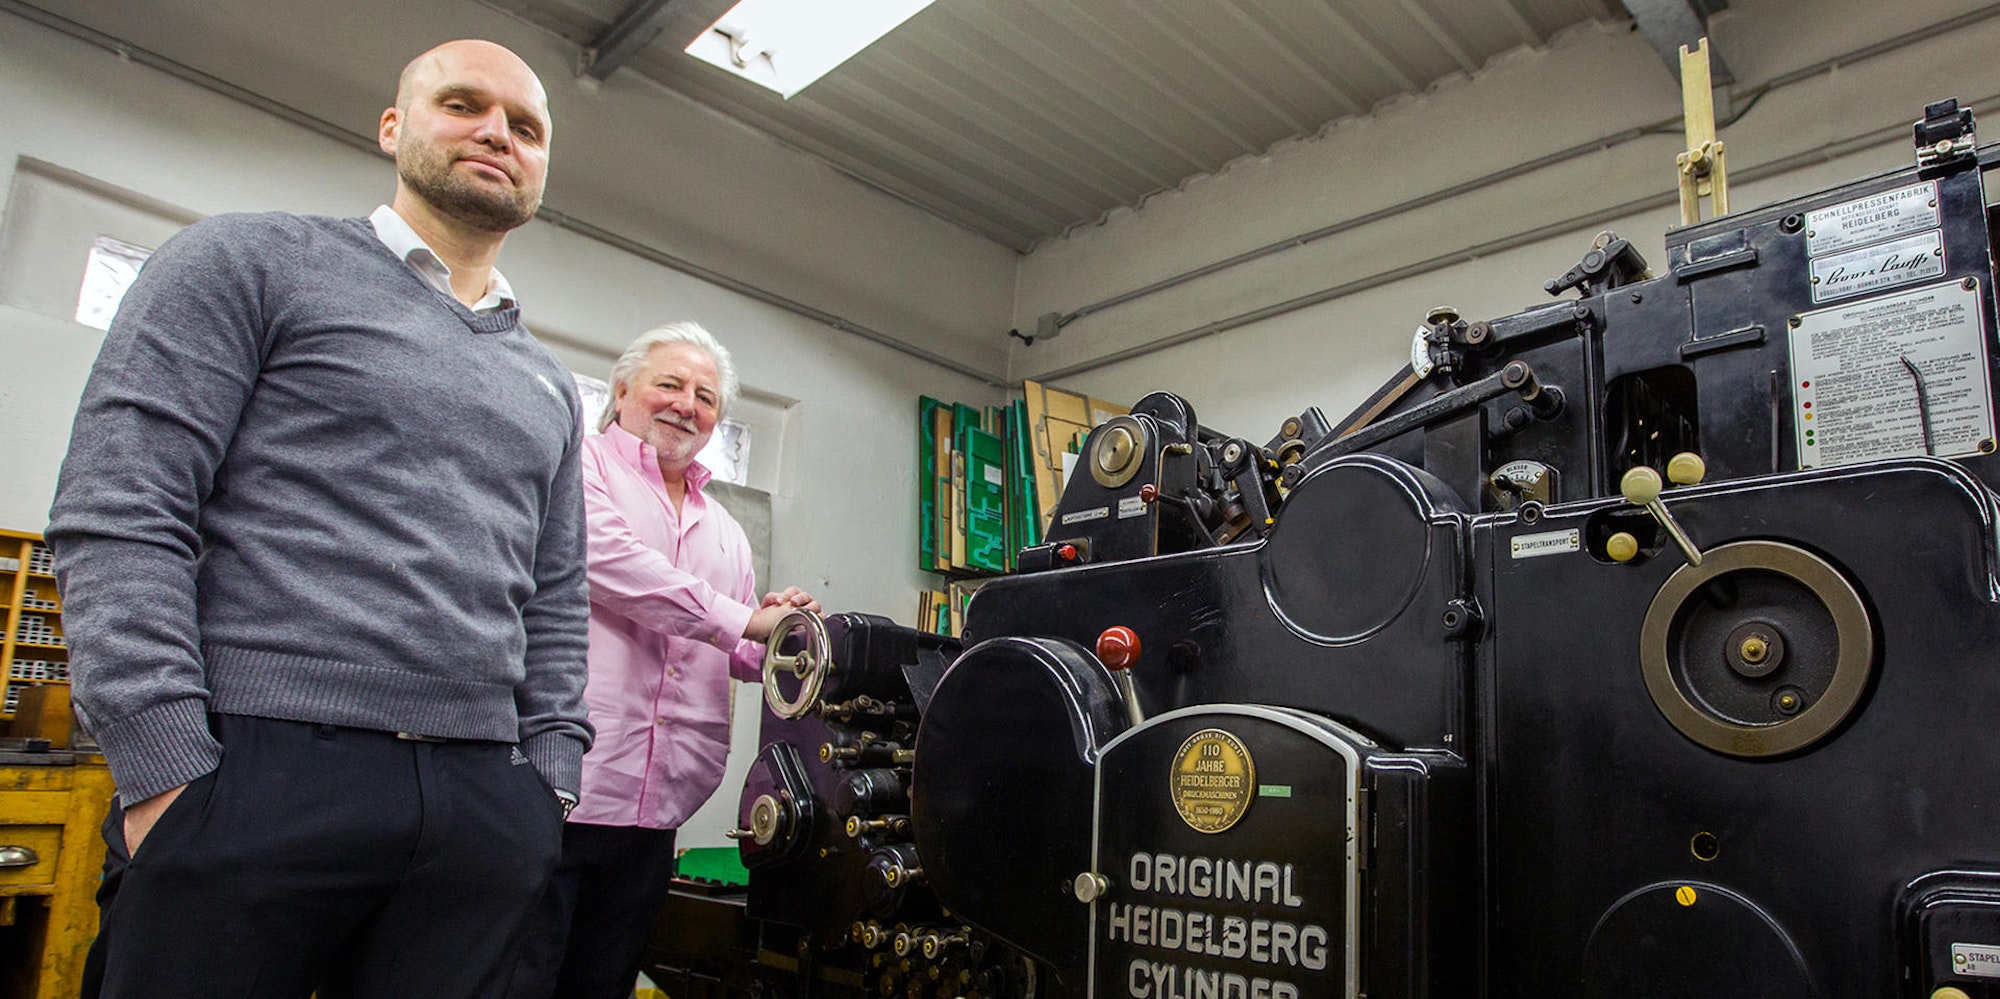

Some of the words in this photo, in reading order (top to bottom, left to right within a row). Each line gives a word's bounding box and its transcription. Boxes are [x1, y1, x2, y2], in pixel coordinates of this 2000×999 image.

[1812, 186, 1930, 222] SCHNELLPRESSENFABRIK
[1842, 209, 1900, 230] HEIDELBERG
[1521, 537, 1569, 550] STAPELTRANSPORT
[1203, 744, 1220, 756] 110
[1196, 760, 1225, 773] JAHRE
[1180, 775, 1241, 788] HEIDELBERGER
[1182, 790, 1237, 799] DRUCKMASCHINEN
[1130, 852, 1303, 908] ORIGINAL
[1108, 902, 1329, 971] HEIDELBERG
